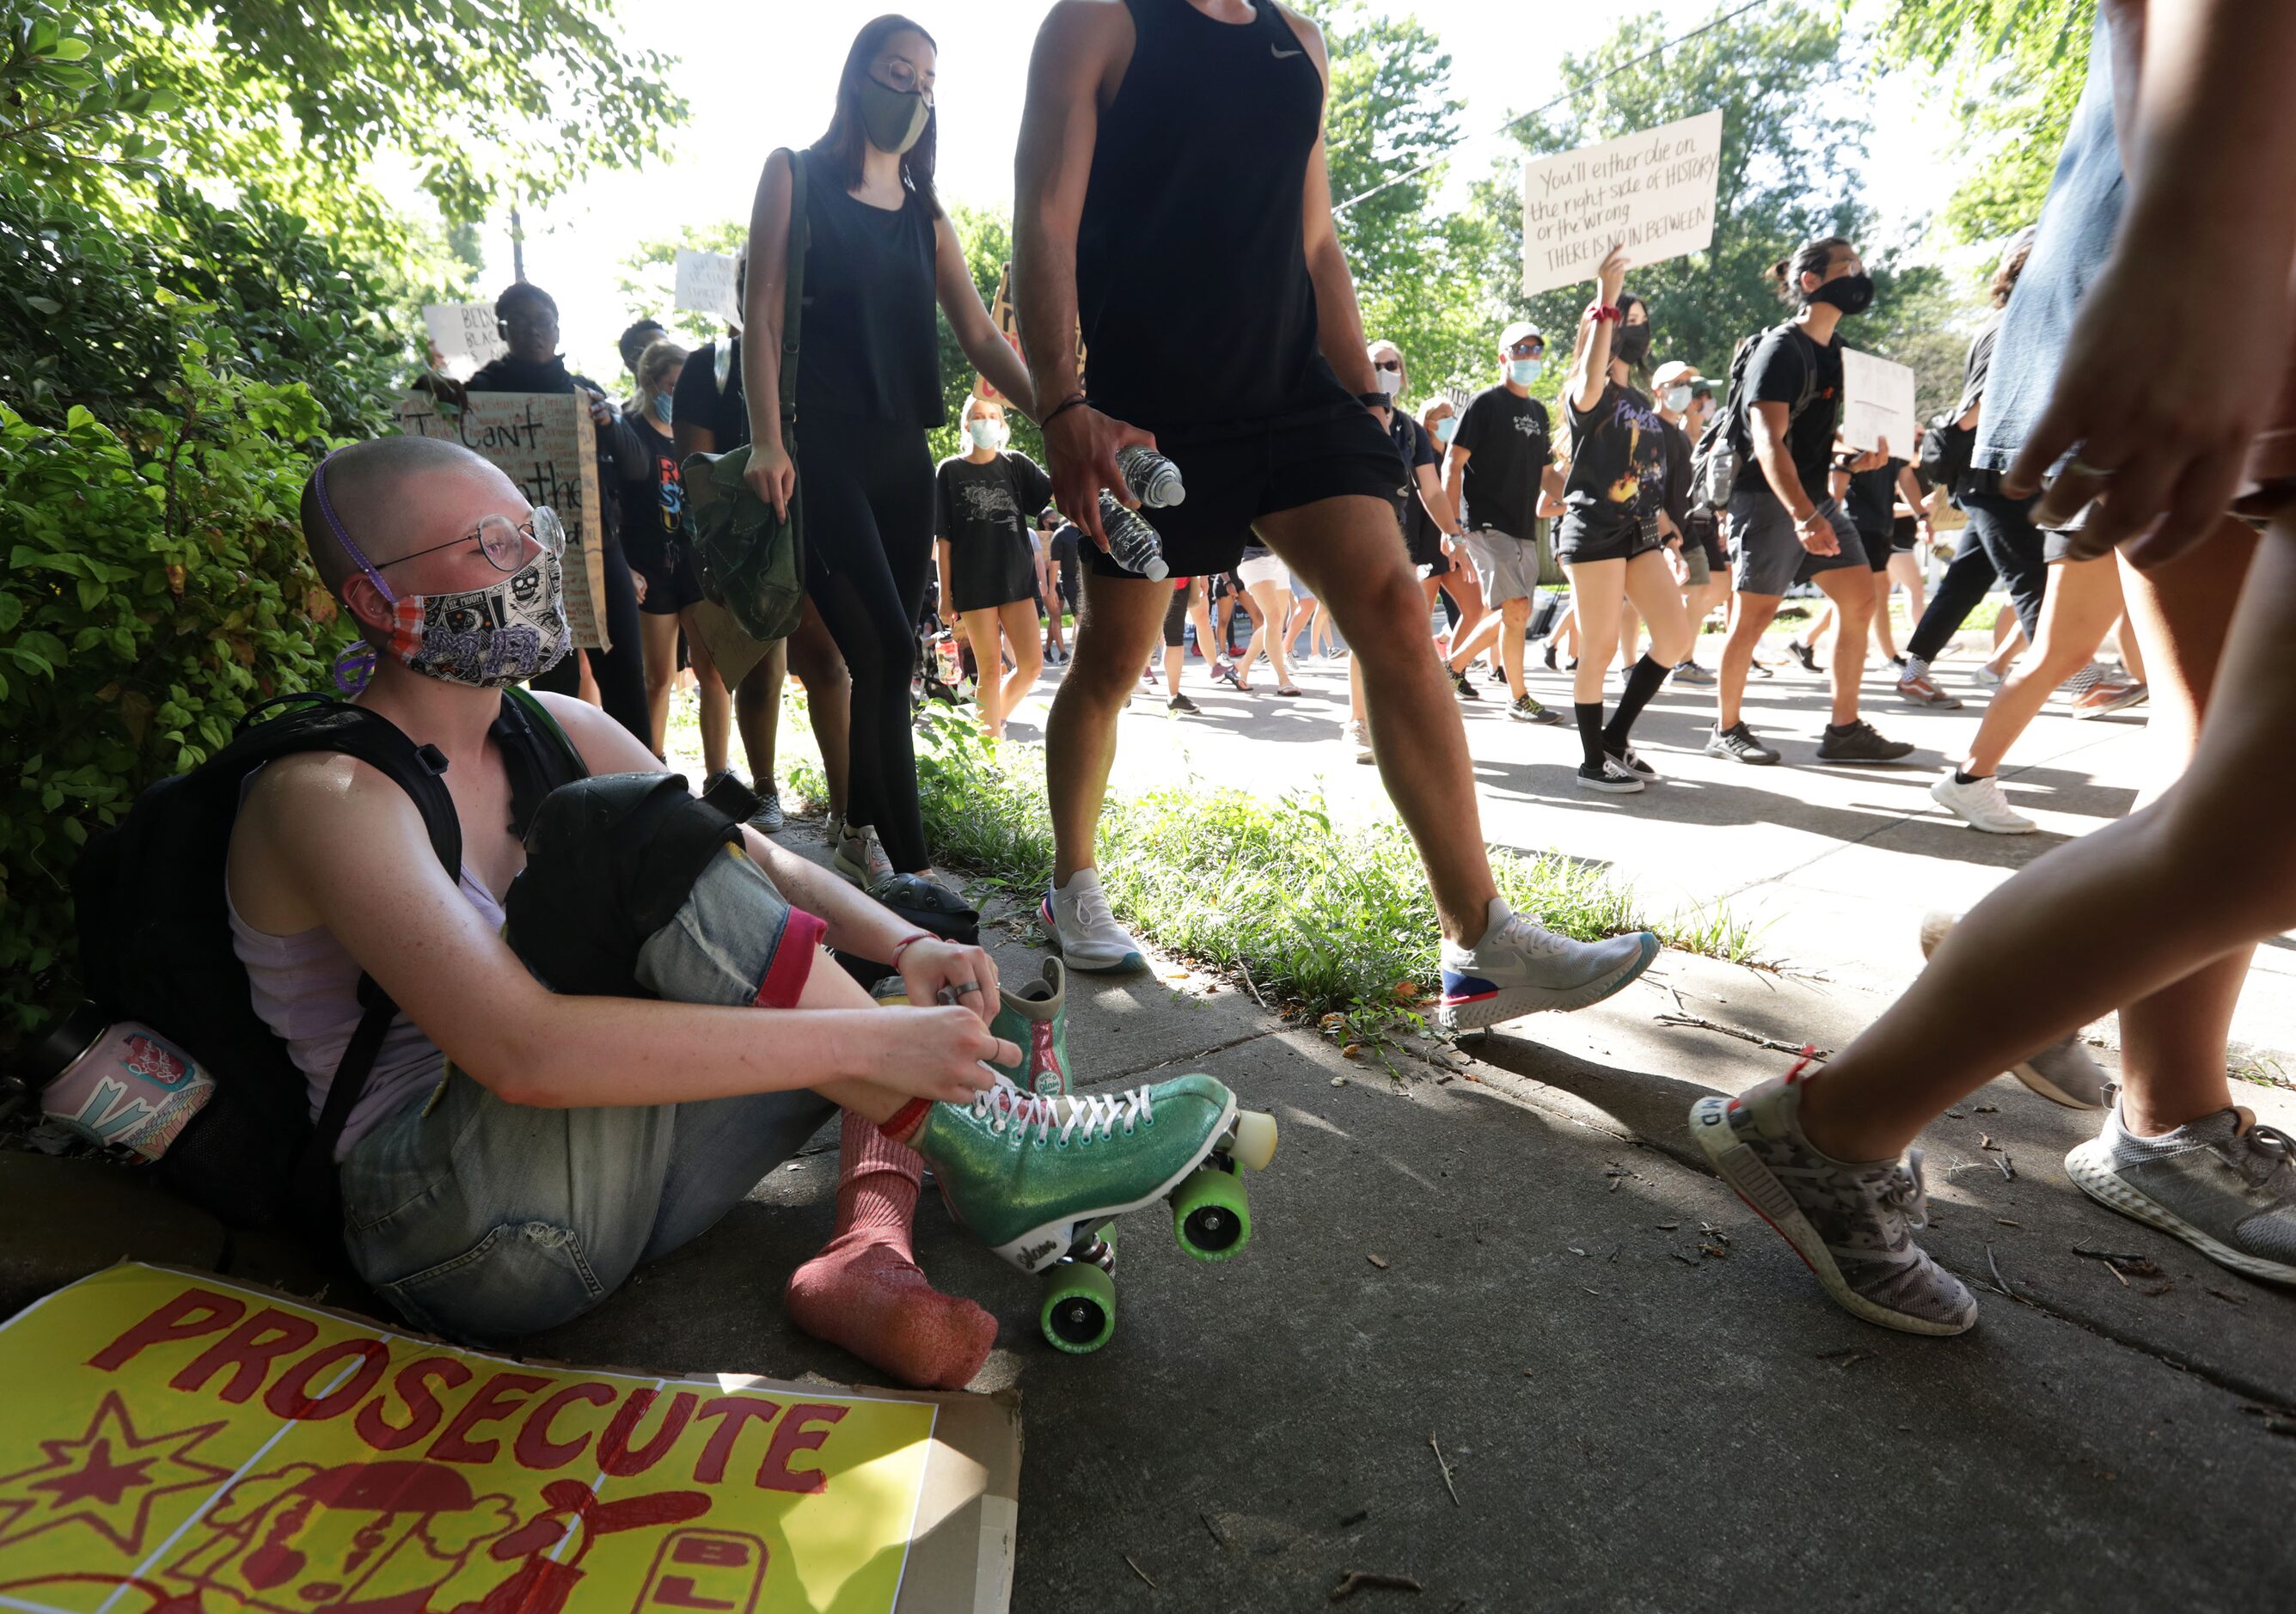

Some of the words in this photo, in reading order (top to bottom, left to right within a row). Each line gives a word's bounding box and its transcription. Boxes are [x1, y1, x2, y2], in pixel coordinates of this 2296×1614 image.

[1540, 161, 1585, 197] You'll
[1592, 151, 1641, 177] either
[1644, 138, 1670, 165] die
[1675, 137, 1697, 156] on
[1530, 200, 1559, 223] the
[1564, 186, 1607, 212] right
[1610, 178, 1641, 199] side
[1646, 169, 1662, 189] of
[1666, 151, 1720, 188] HISTORY
[1537, 223, 1558, 241] or
[1558, 216, 1580, 242] the
[1584, 203, 1631, 228] wrong
[1545, 245, 1589, 272] THERE
[1592, 235, 1605, 257] IS
[1607, 229, 1626, 250] NO
[1628, 224, 1643, 246] IN
[1645, 201, 1707, 243] BETWEEN
[461, 306, 496, 328] BEIN
[463, 329, 499, 349] BLAC
[1038, 1073, 1057, 1082] DISCO
[1038, 1079, 1060, 1095] glam
[82, 1287, 851, 1495] PROSECUTE
